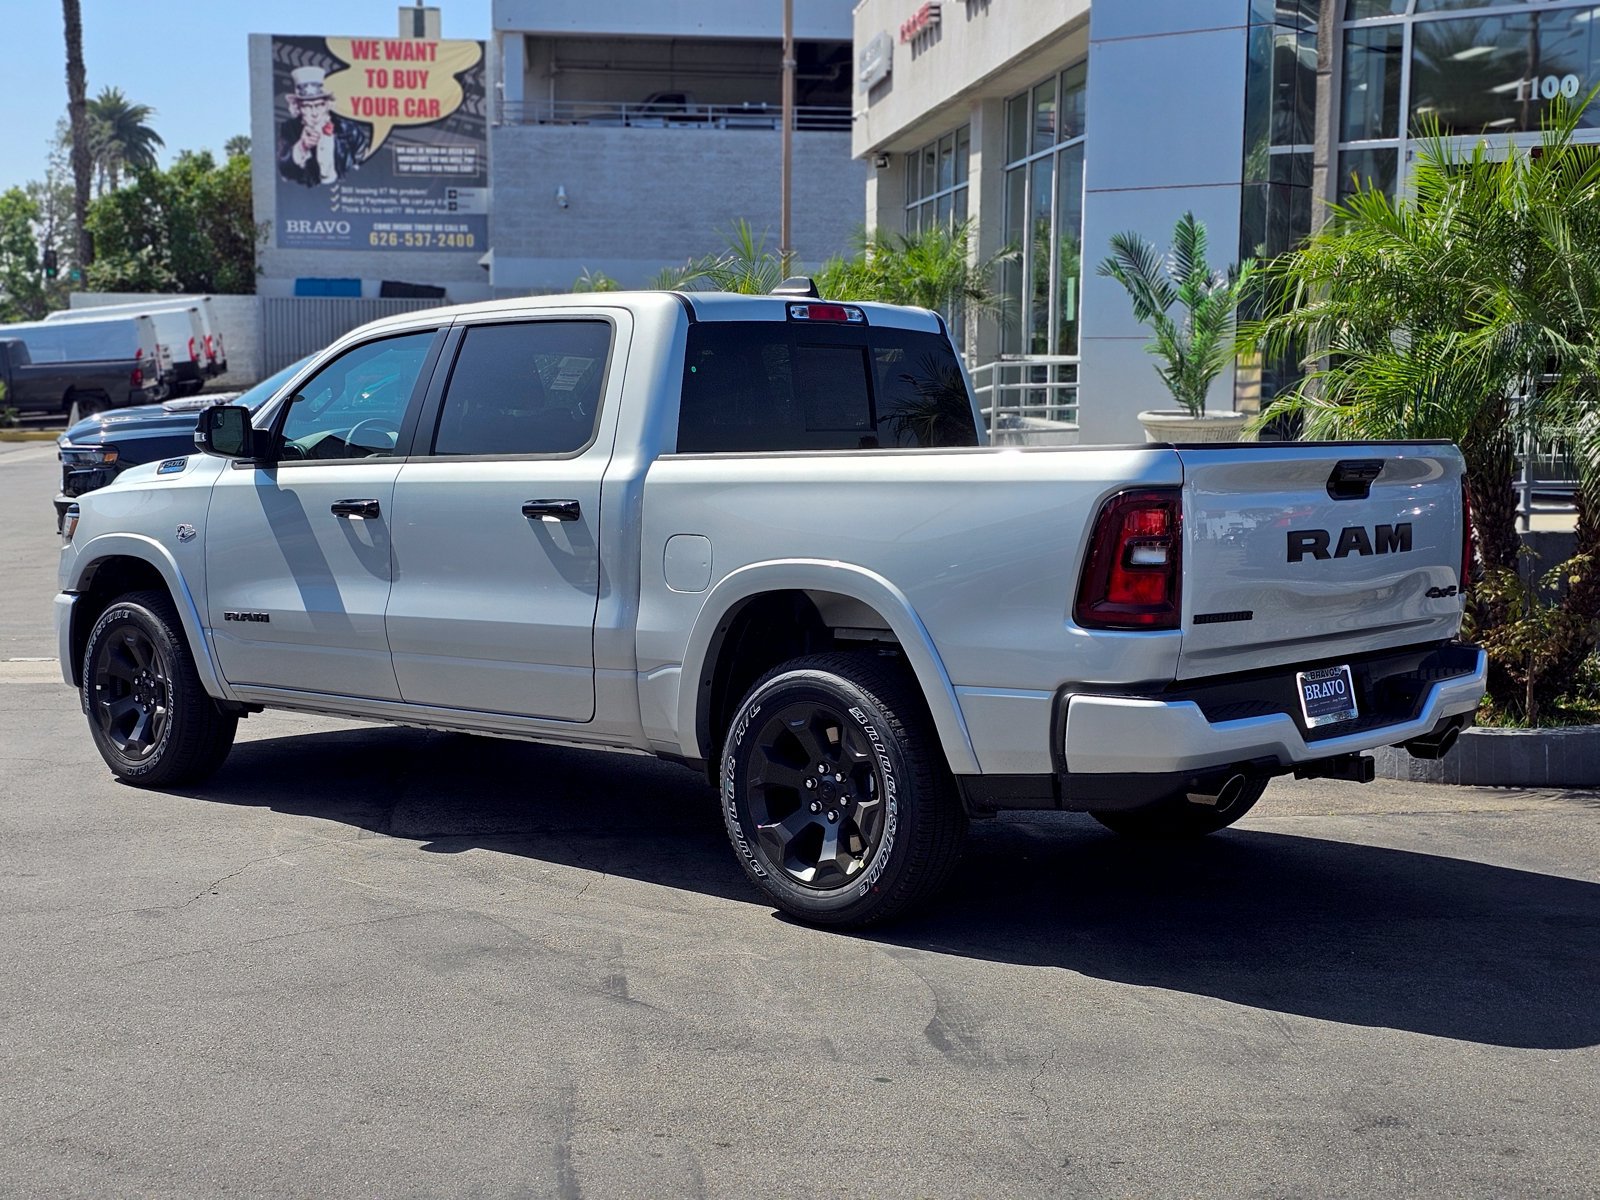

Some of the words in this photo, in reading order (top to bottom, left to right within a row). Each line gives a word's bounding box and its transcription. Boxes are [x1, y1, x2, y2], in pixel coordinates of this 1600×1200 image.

[351, 40, 380, 60] WE
[384, 41, 438, 61] WANT
[365, 68, 388, 89] TO
[393, 69, 429, 90] BUY
[1514, 74, 1579, 101] 1100
[350, 96, 399, 117] YOUR
[404, 97, 440, 118] CAR
[286, 220, 350, 234] BRAVO
[369, 232, 474, 246] 626-537-2400
[1287, 522, 1412, 563] RAM
[1425, 585, 1458, 599] 4x4
[224, 611, 270, 623] RAM
[1310, 668, 1335, 680] BRAVO
[1304, 679, 1346, 701] BRAVO
[848, 706, 897, 896] BRIDGESTONE
[726, 755, 767, 877] DUELER
